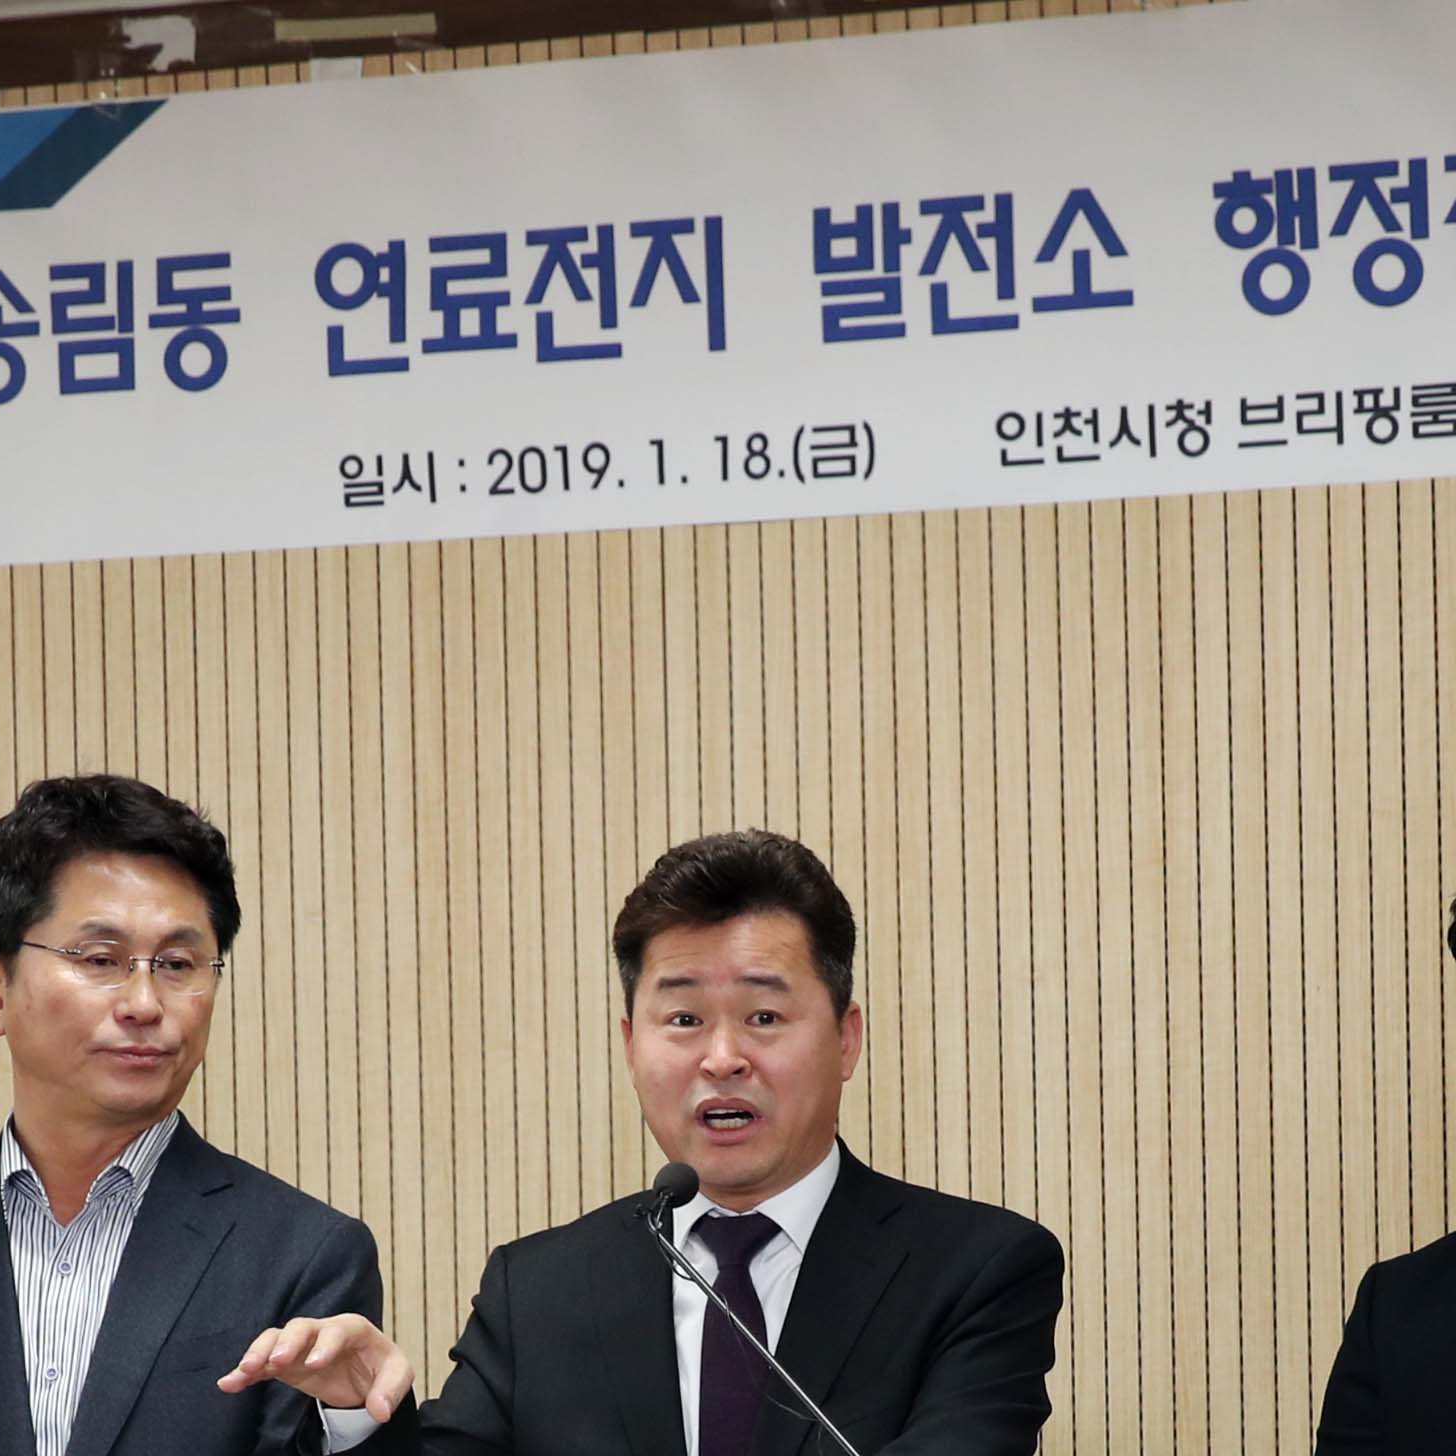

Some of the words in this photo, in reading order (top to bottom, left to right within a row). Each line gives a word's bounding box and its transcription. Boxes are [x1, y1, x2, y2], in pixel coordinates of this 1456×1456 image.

[313, 215, 728, 378] 연료전지
[812, 187, 1135, 344] 발전소
[486, 440, 627, 497] 2019.
[647, 437, 690, 487] 1.
[712, 421, 877, 485] 18.(금)
[994, 398, 1214, 469] 인천시청
